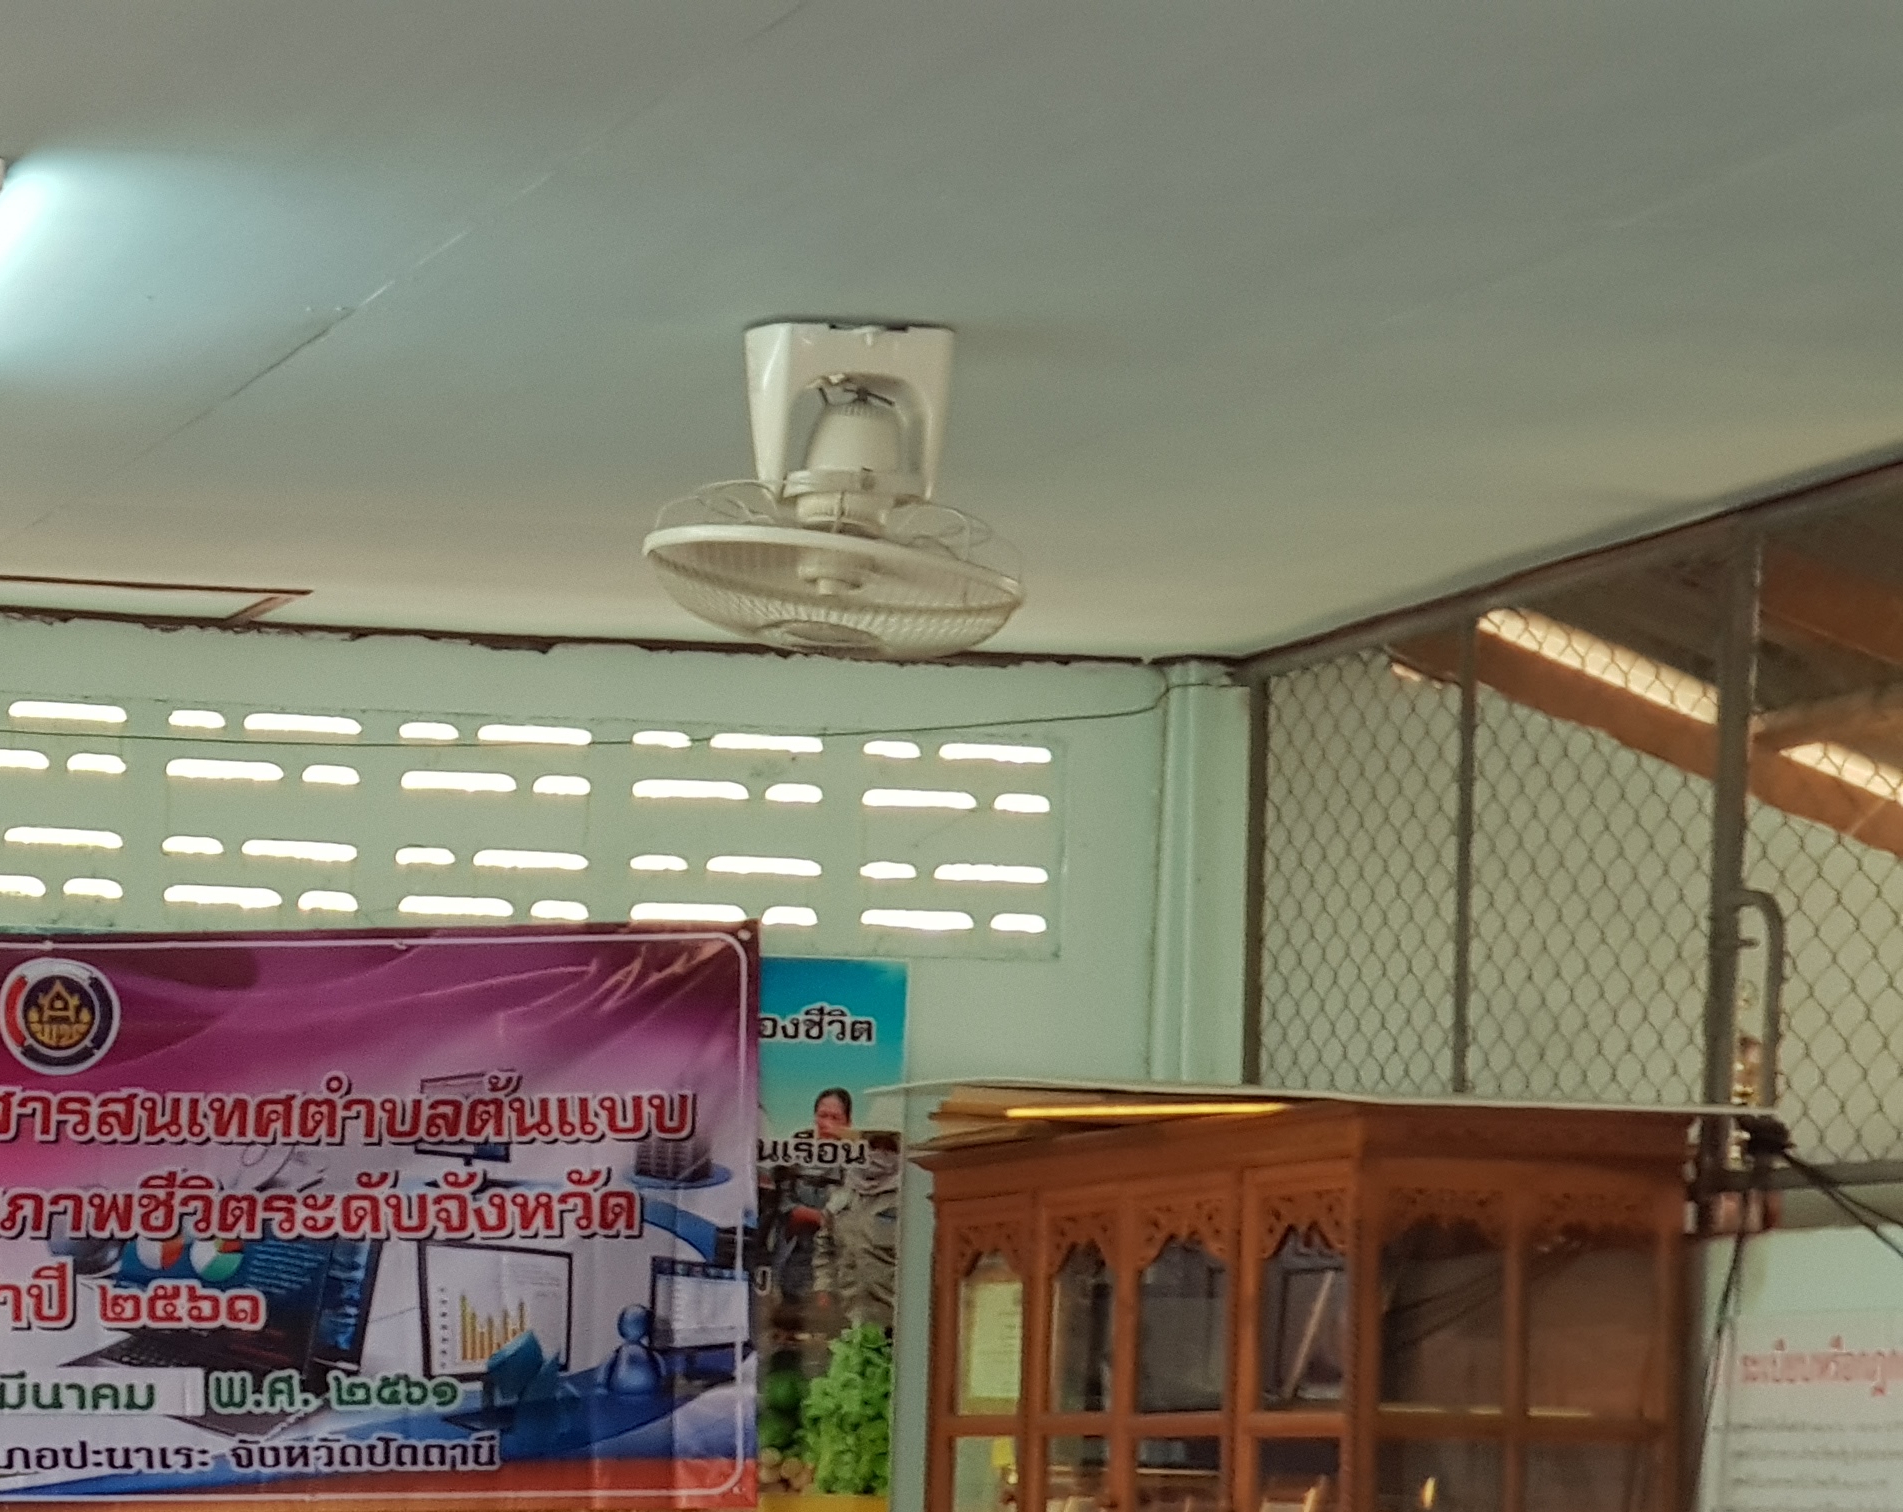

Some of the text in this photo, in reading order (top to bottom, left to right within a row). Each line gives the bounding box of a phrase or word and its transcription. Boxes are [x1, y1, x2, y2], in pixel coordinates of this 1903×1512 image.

[98, 1282, 265, 1326] ๒๕๖๑
[212, 1371, 312, 1410] พ.ศ.
[330, 1373, 461, 1408] ๒๕๖๑
[230, 1433, 501, 1470] จังหวัดปัตตานี
